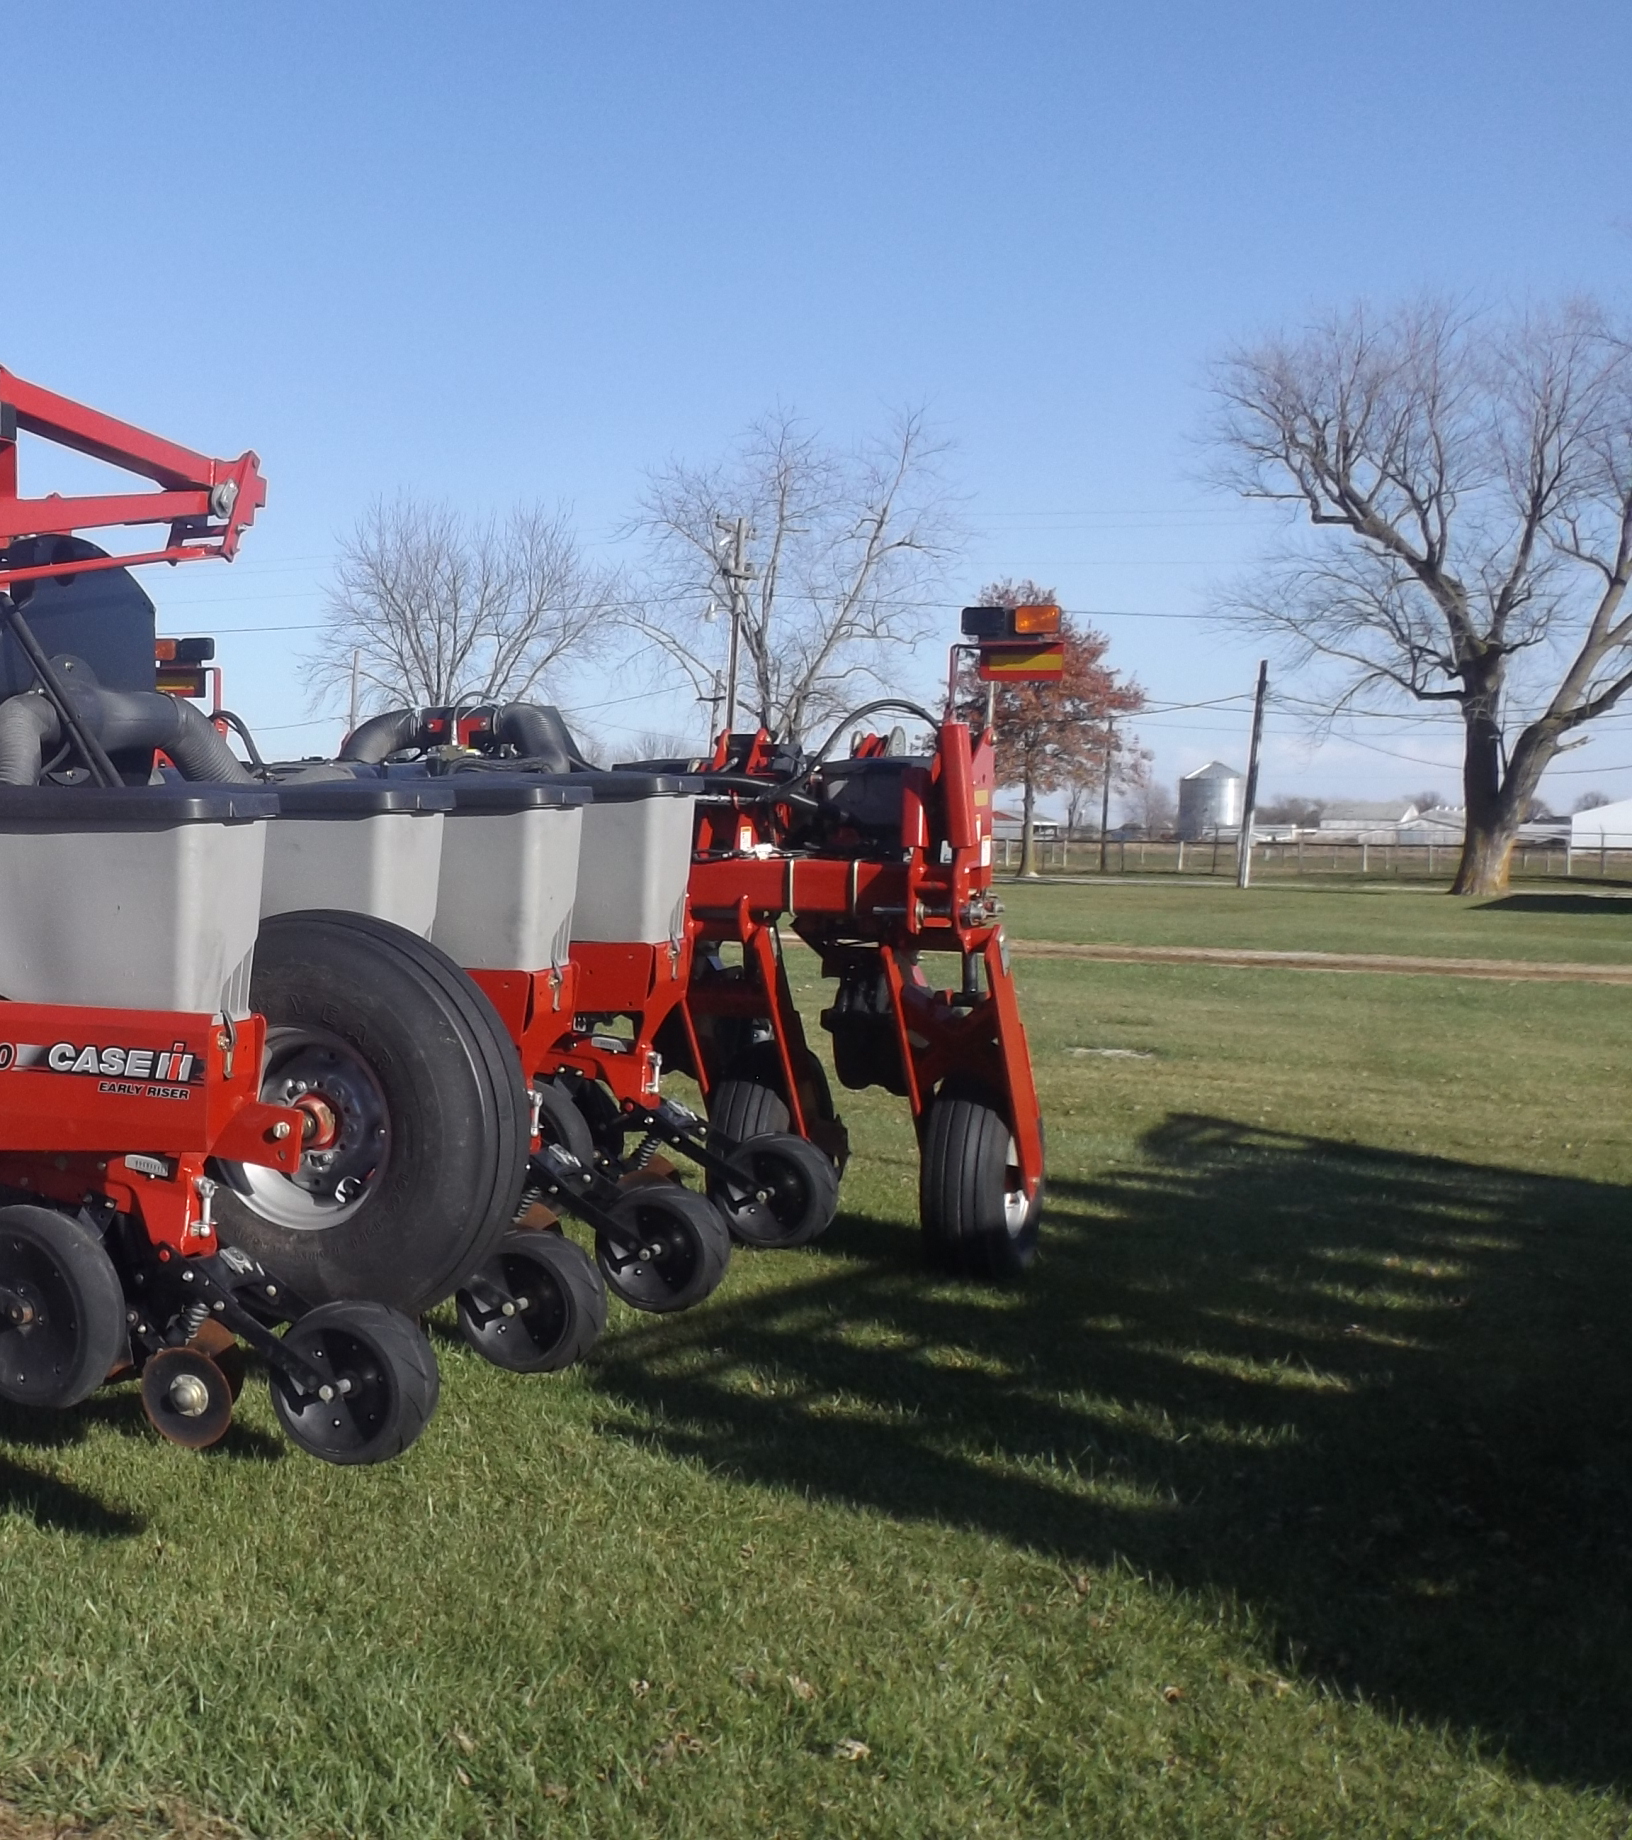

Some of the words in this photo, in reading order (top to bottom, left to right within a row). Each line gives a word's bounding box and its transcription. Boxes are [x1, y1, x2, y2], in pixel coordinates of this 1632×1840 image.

[49, 1043, 154, 1078] CASE
[98, 1081, 144, 1094] EARLY
[146, 1086, 190, 1100] RISER
